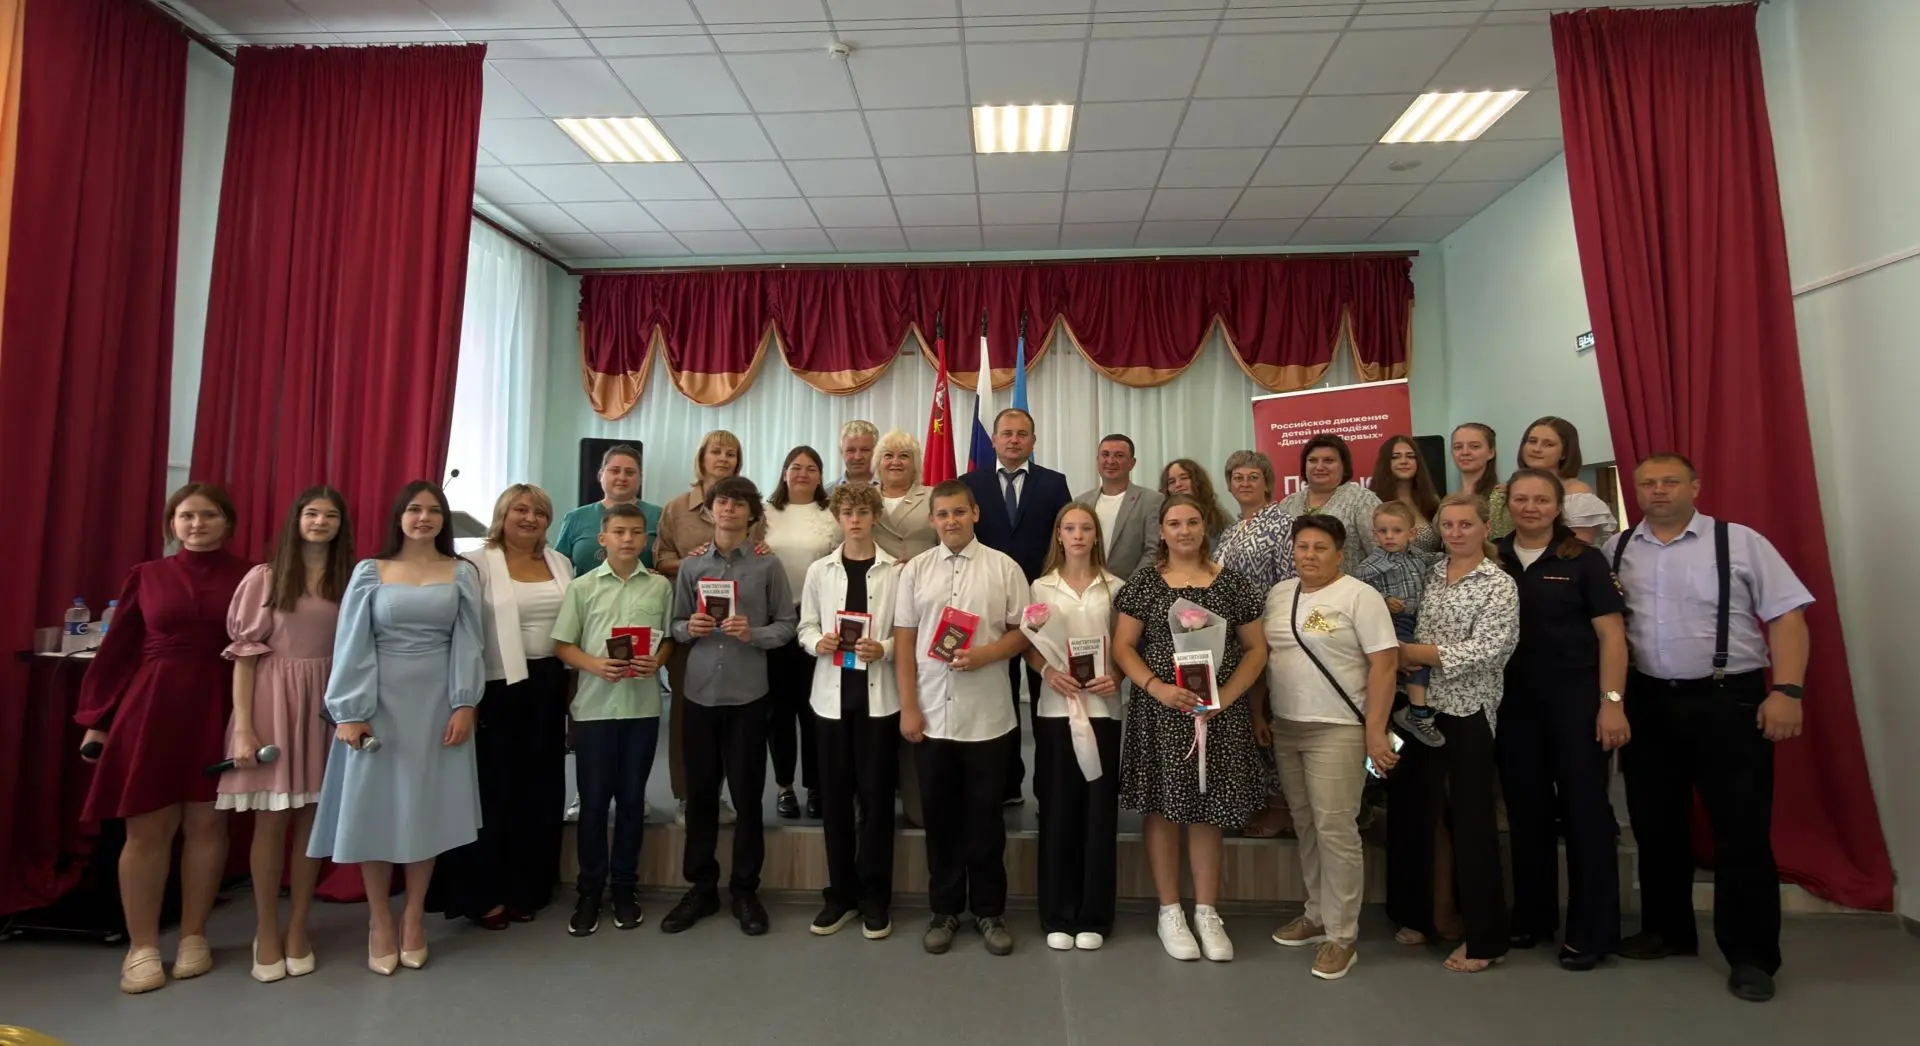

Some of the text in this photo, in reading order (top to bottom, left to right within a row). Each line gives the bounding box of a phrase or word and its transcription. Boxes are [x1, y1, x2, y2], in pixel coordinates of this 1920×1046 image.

[1271, 414, 1389, 430] Российское движение
[1282, 429, 1311, 438] детей
[1321, 424, 1378, 433] молодёжи
